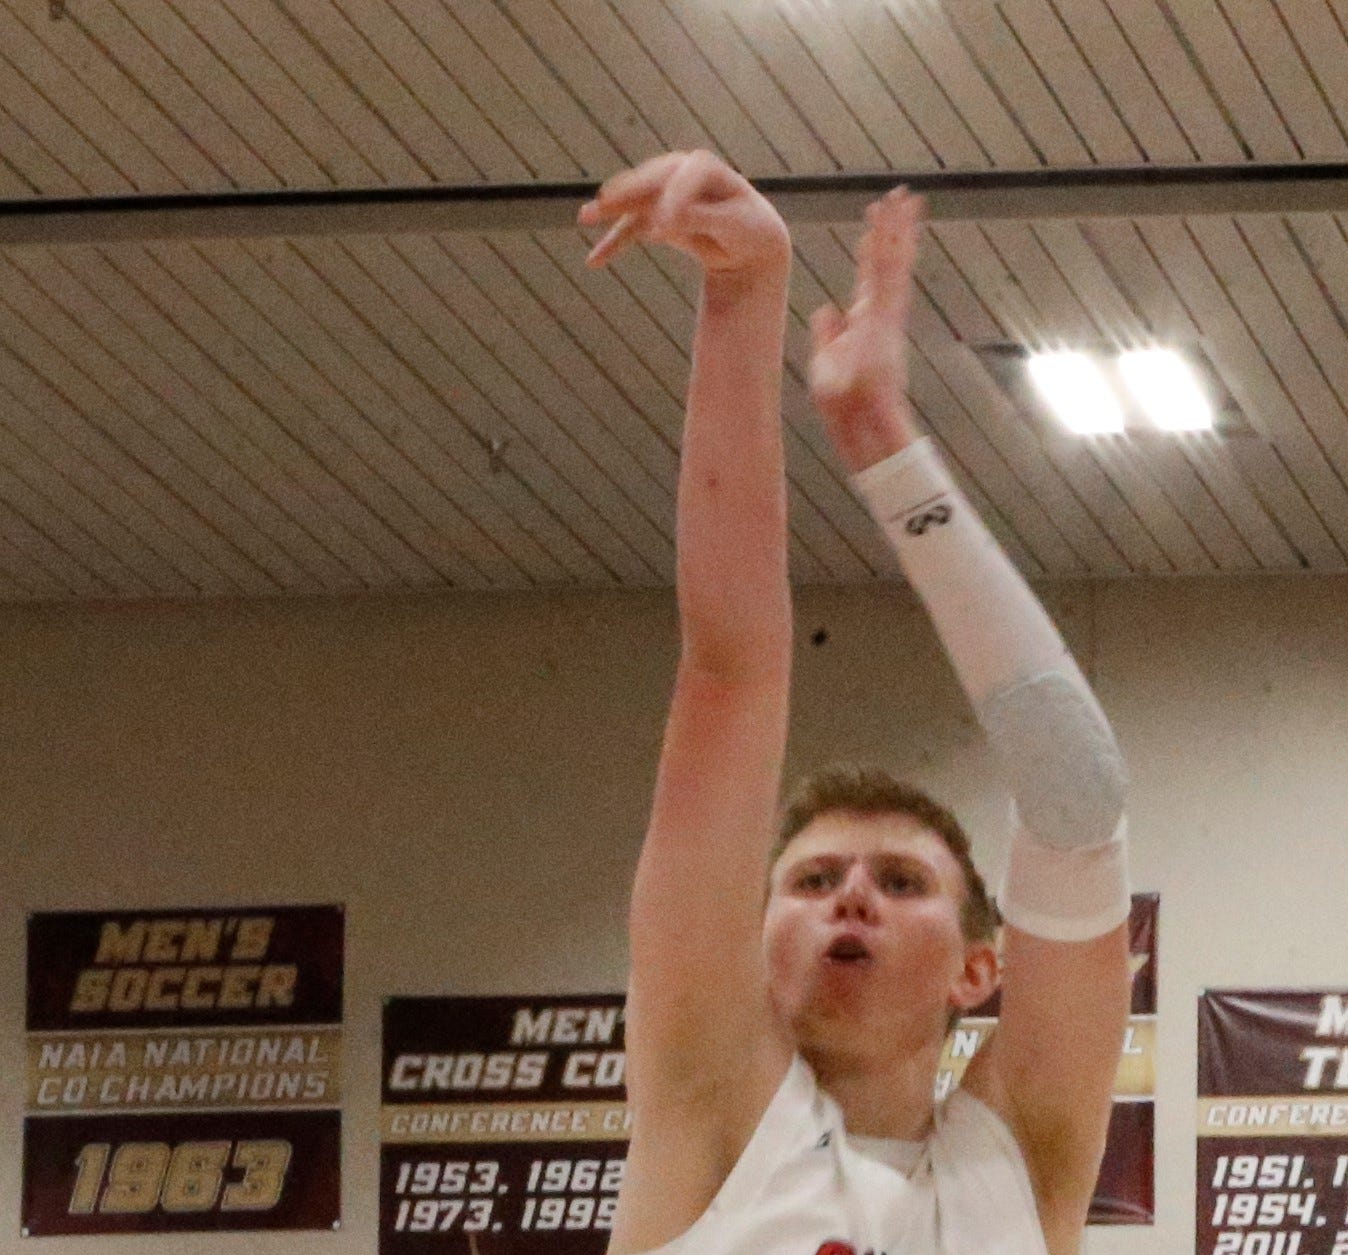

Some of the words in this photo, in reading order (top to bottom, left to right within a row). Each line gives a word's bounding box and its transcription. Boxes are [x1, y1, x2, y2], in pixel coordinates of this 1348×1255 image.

[94, 916, 275, 963] MEN'S
[69, 963, 298, 1013] SOCCER
[38, 1041, 127, 1069] NAIA
[144, 1036, 329, 1067] NATIONAL
[99, 1069, 329, 1104] CHAMPIONS
[389, 1053, 550, 1090] CROSS
[391, 1110, 591, 1135] CONFERENCE
